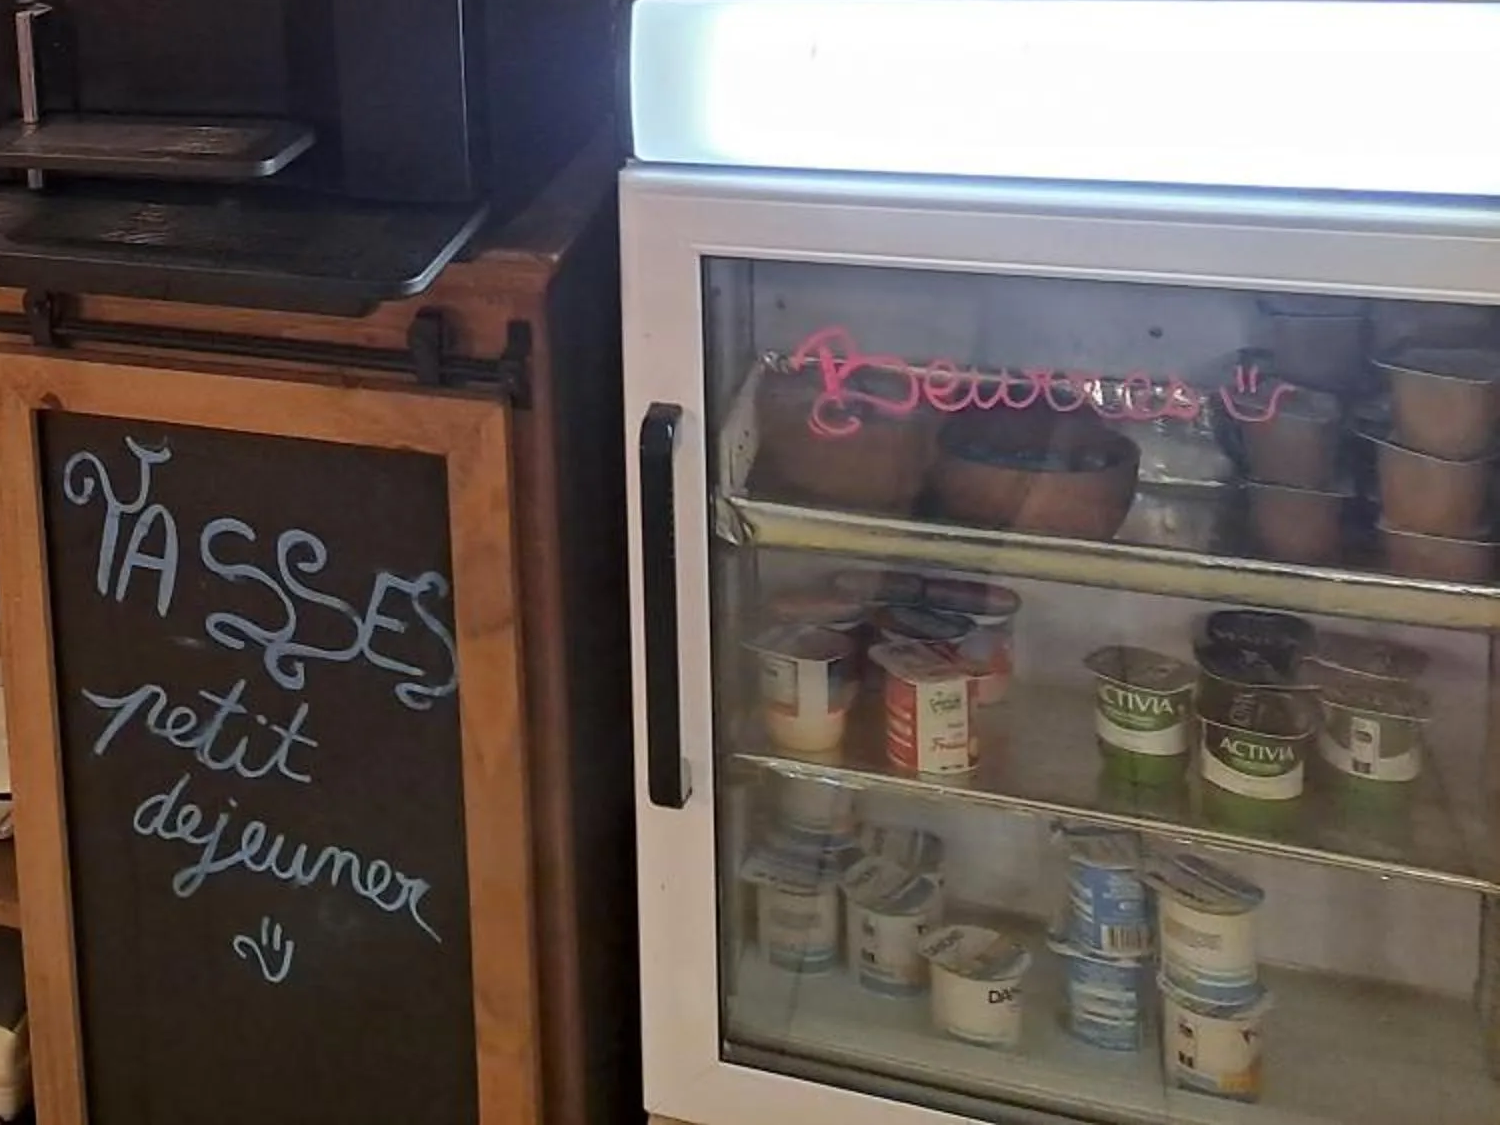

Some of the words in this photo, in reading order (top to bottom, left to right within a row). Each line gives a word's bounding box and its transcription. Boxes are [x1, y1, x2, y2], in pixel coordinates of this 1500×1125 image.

[64, 435, 458, 710] TASSES
[81, 678, 318, 783] petit
[1101, 684, 1174, 715] CTIVIA
[1220, 736, 1295, 762] ACTIVIA
[132, 772, 443, 943] dejeuner
